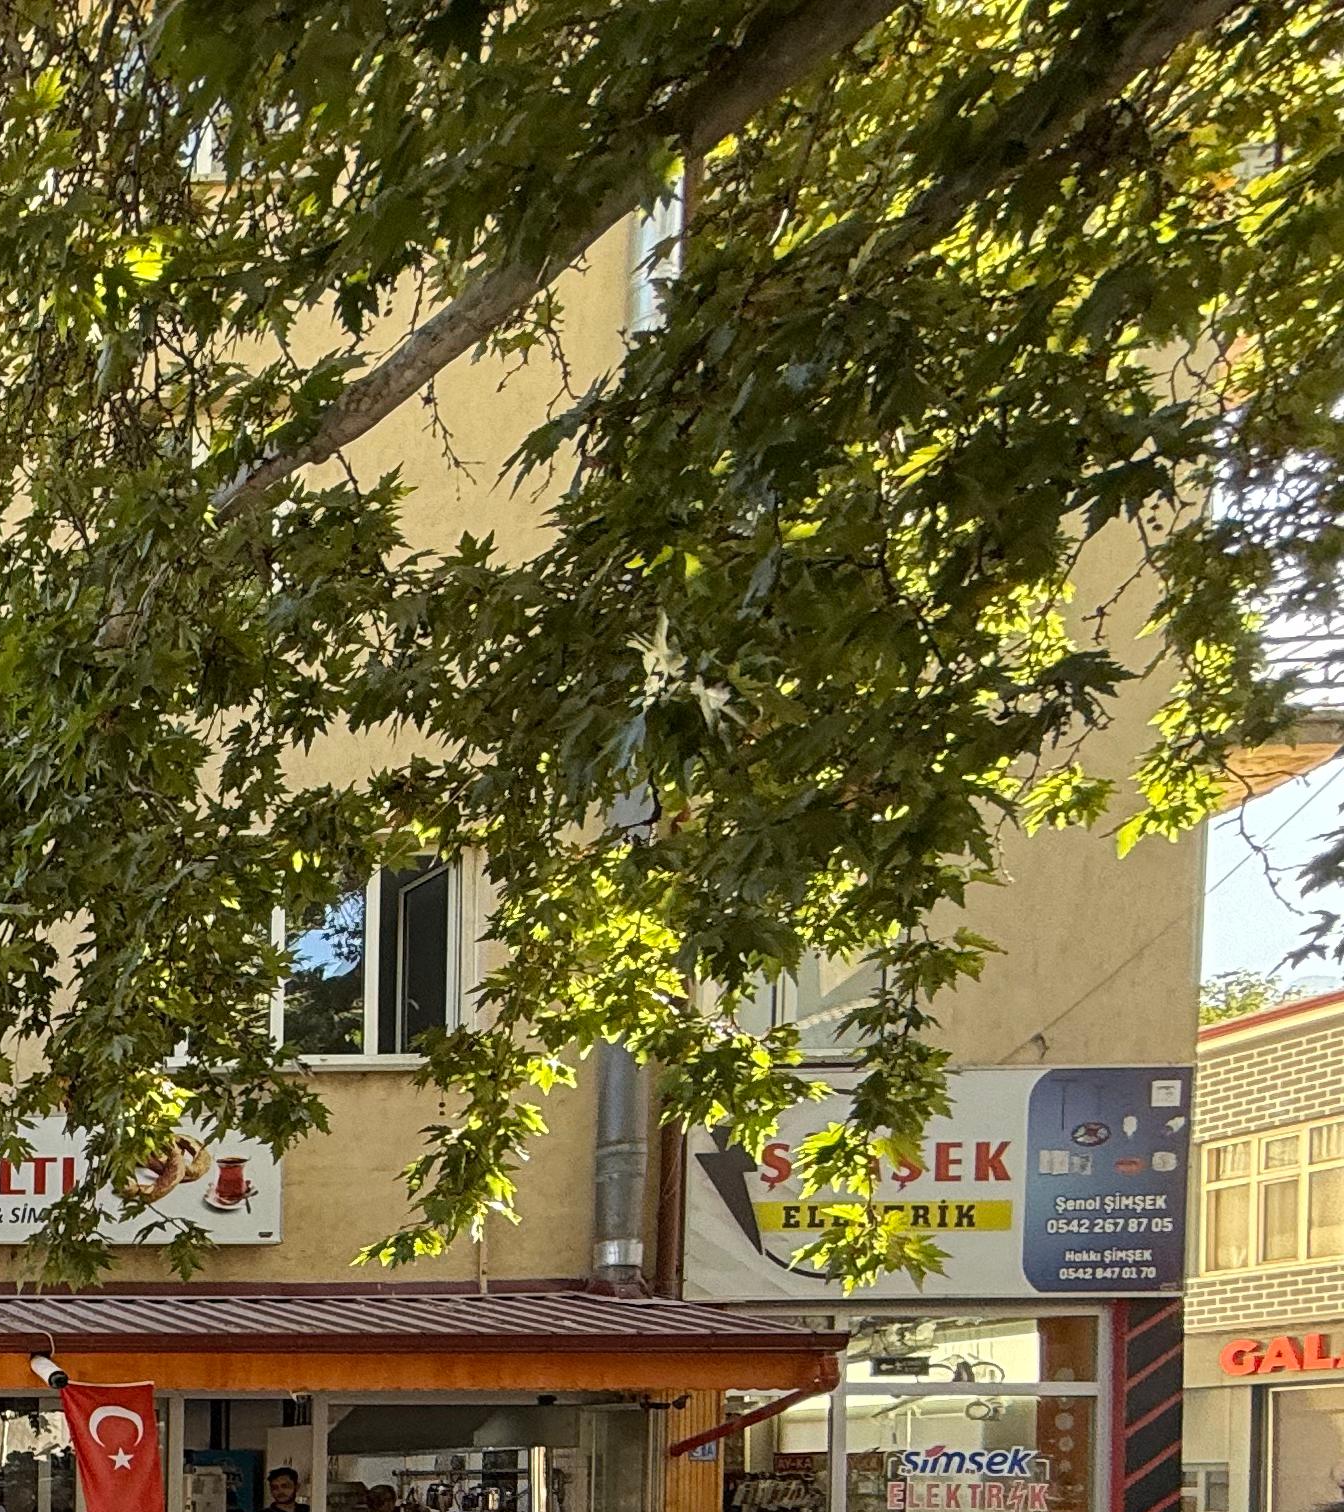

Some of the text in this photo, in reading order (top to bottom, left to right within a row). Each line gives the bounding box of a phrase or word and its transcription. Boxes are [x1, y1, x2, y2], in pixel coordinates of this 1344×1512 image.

[1055, 1192, 1167, 1213] Şenol ŞİMŞEK
[1047, 1217, 1173, 1234] 0542 267 87 05
[1103, 1247, 1152, 1264] ŞİMŞEK
[1059, 1266, 1156, 1279] 0542 847 01 70
[1219, 1333, 1344, 1376] GAL
